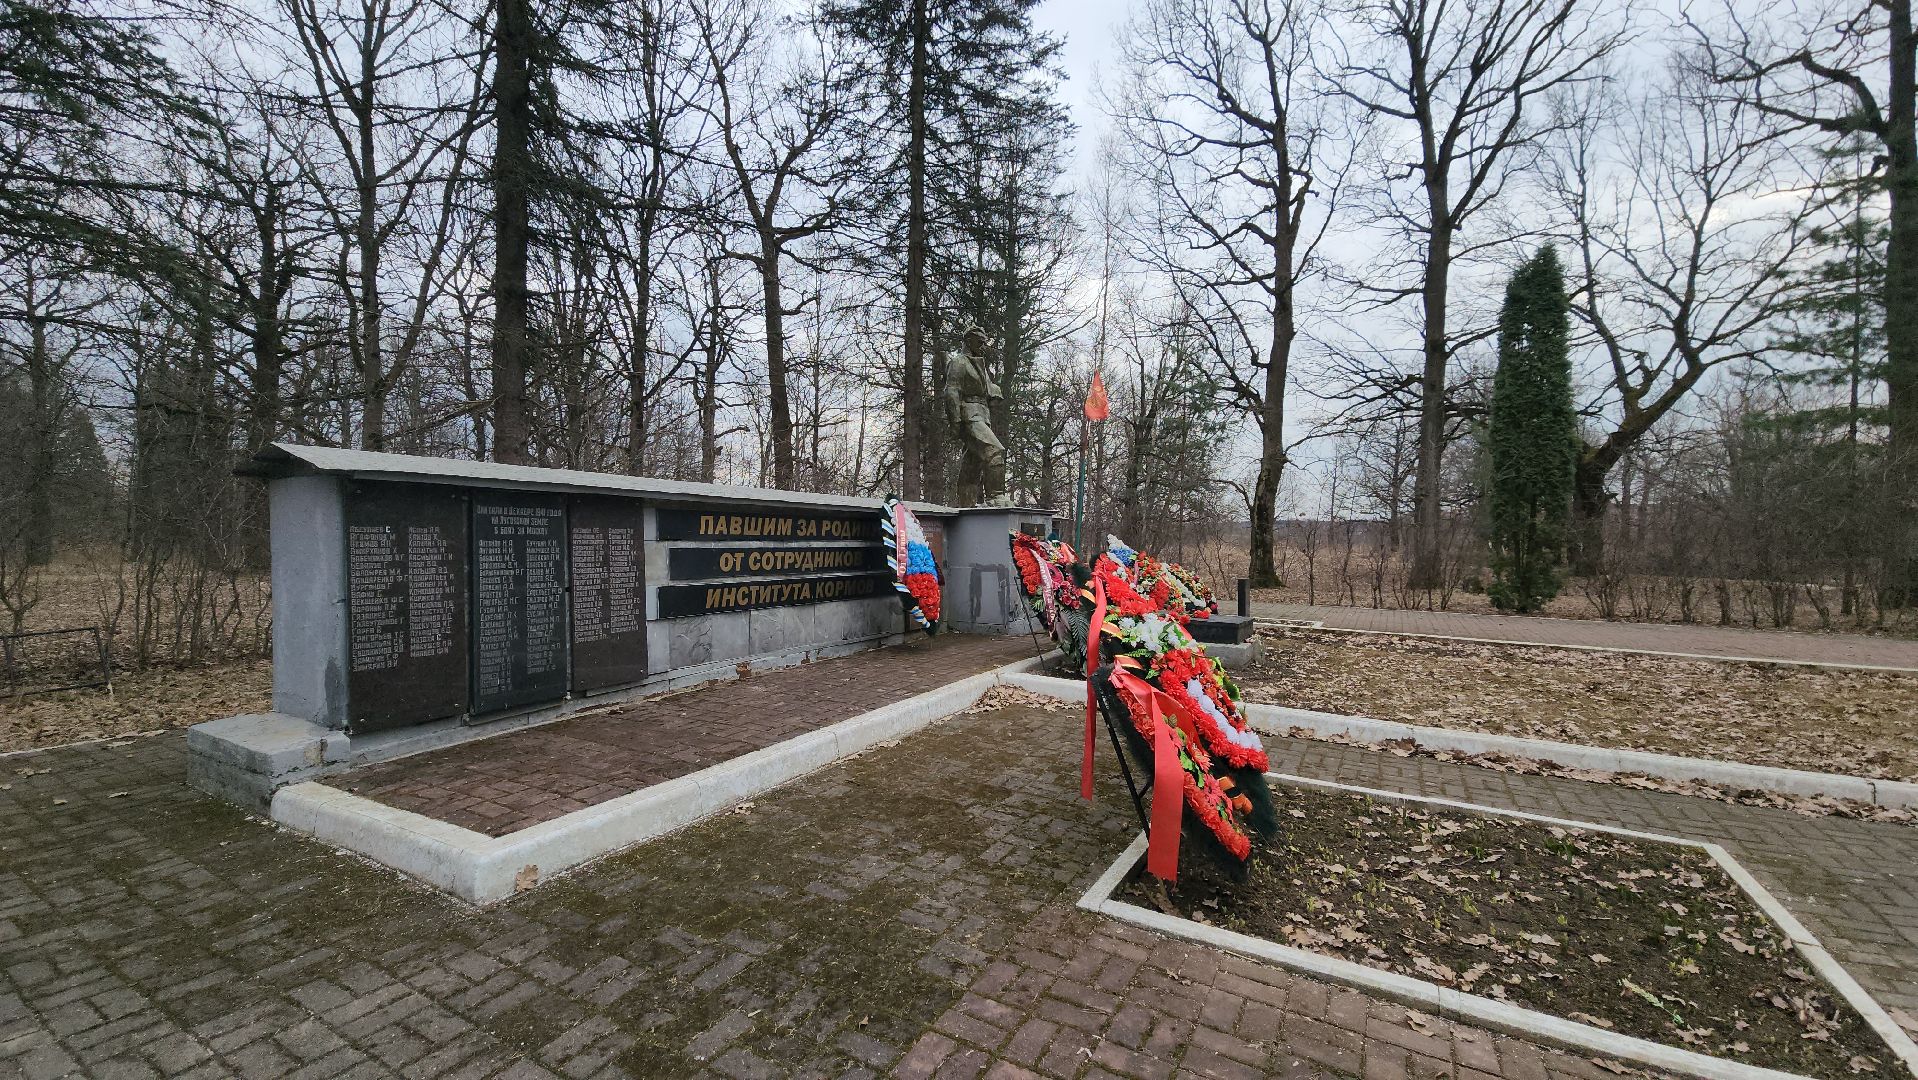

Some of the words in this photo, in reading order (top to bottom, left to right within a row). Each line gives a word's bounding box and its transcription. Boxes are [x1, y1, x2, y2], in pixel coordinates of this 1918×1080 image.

[700, 516, 792, 536] ПАВШИМ
[797, 520, 816, 536] ЗА
[720, 552, 744, 572] ОТ
[750, 552, 863, 571] СОТРУДНИКОВ
[706, 582, 811, 608] ИНСТИТУТА
[816, 578, 874, 599] КОРМОВ
